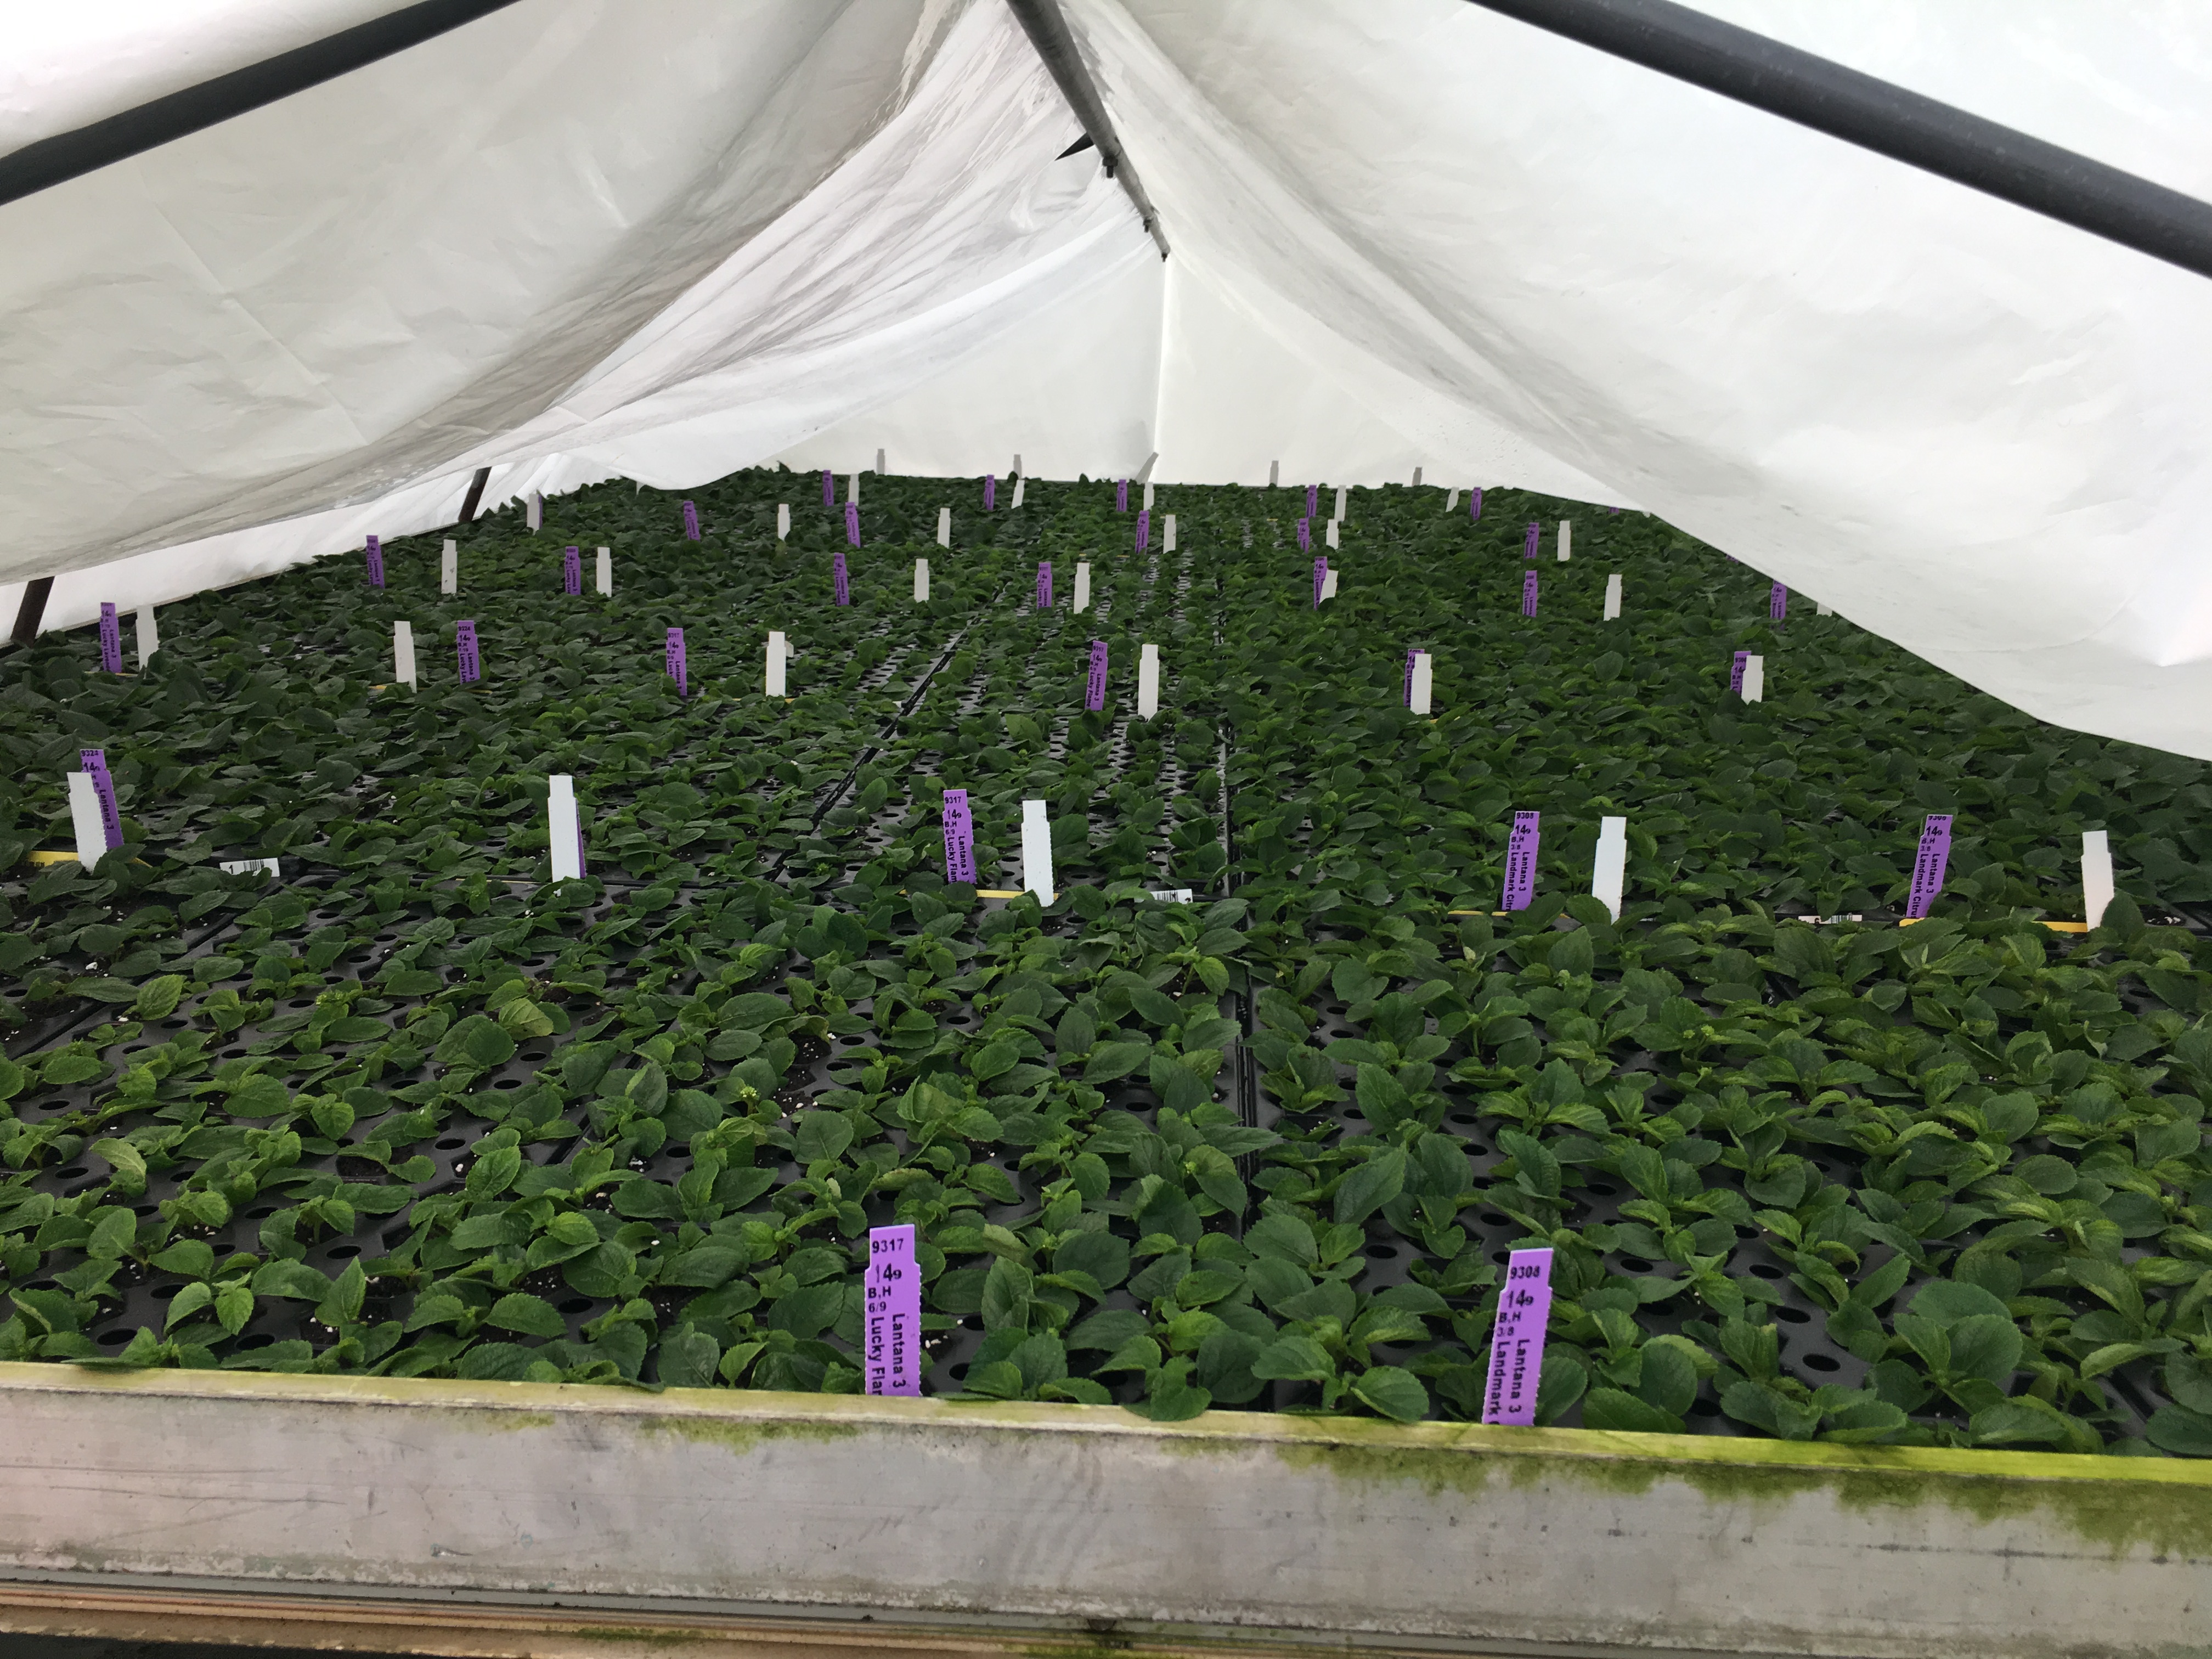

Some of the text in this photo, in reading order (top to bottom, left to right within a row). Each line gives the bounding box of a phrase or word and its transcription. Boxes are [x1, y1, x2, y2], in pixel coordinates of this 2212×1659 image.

[99, 789, 111, 822] Lantana
[947, 837, 956, 861] Lucky
[958, 836, 967, 868] Lantana
[1508, 852, 1520, 892] Landmark
[1520, 852, 1530, 884] Lantana
[1914, 854, 1929, 894] Landmark
[1928, 854, 1940, 886] Lantana
[872, 1238, 904, 1253] 9317
[876, 1263, 902, 1284] 149
[1510, 1266, 1540, 1279] 9308
[868, 1301, 887, 1313] 6/9
[1506, 1289, 1534, 1308] 149
[868, 1316, 885, 1362] Lucky
[892, 1313, 906, 1388] Lantana 3
[1488, 1341, 1511, 1416] Landmark
[1511, 1339, 1531, 1400] Lantana
